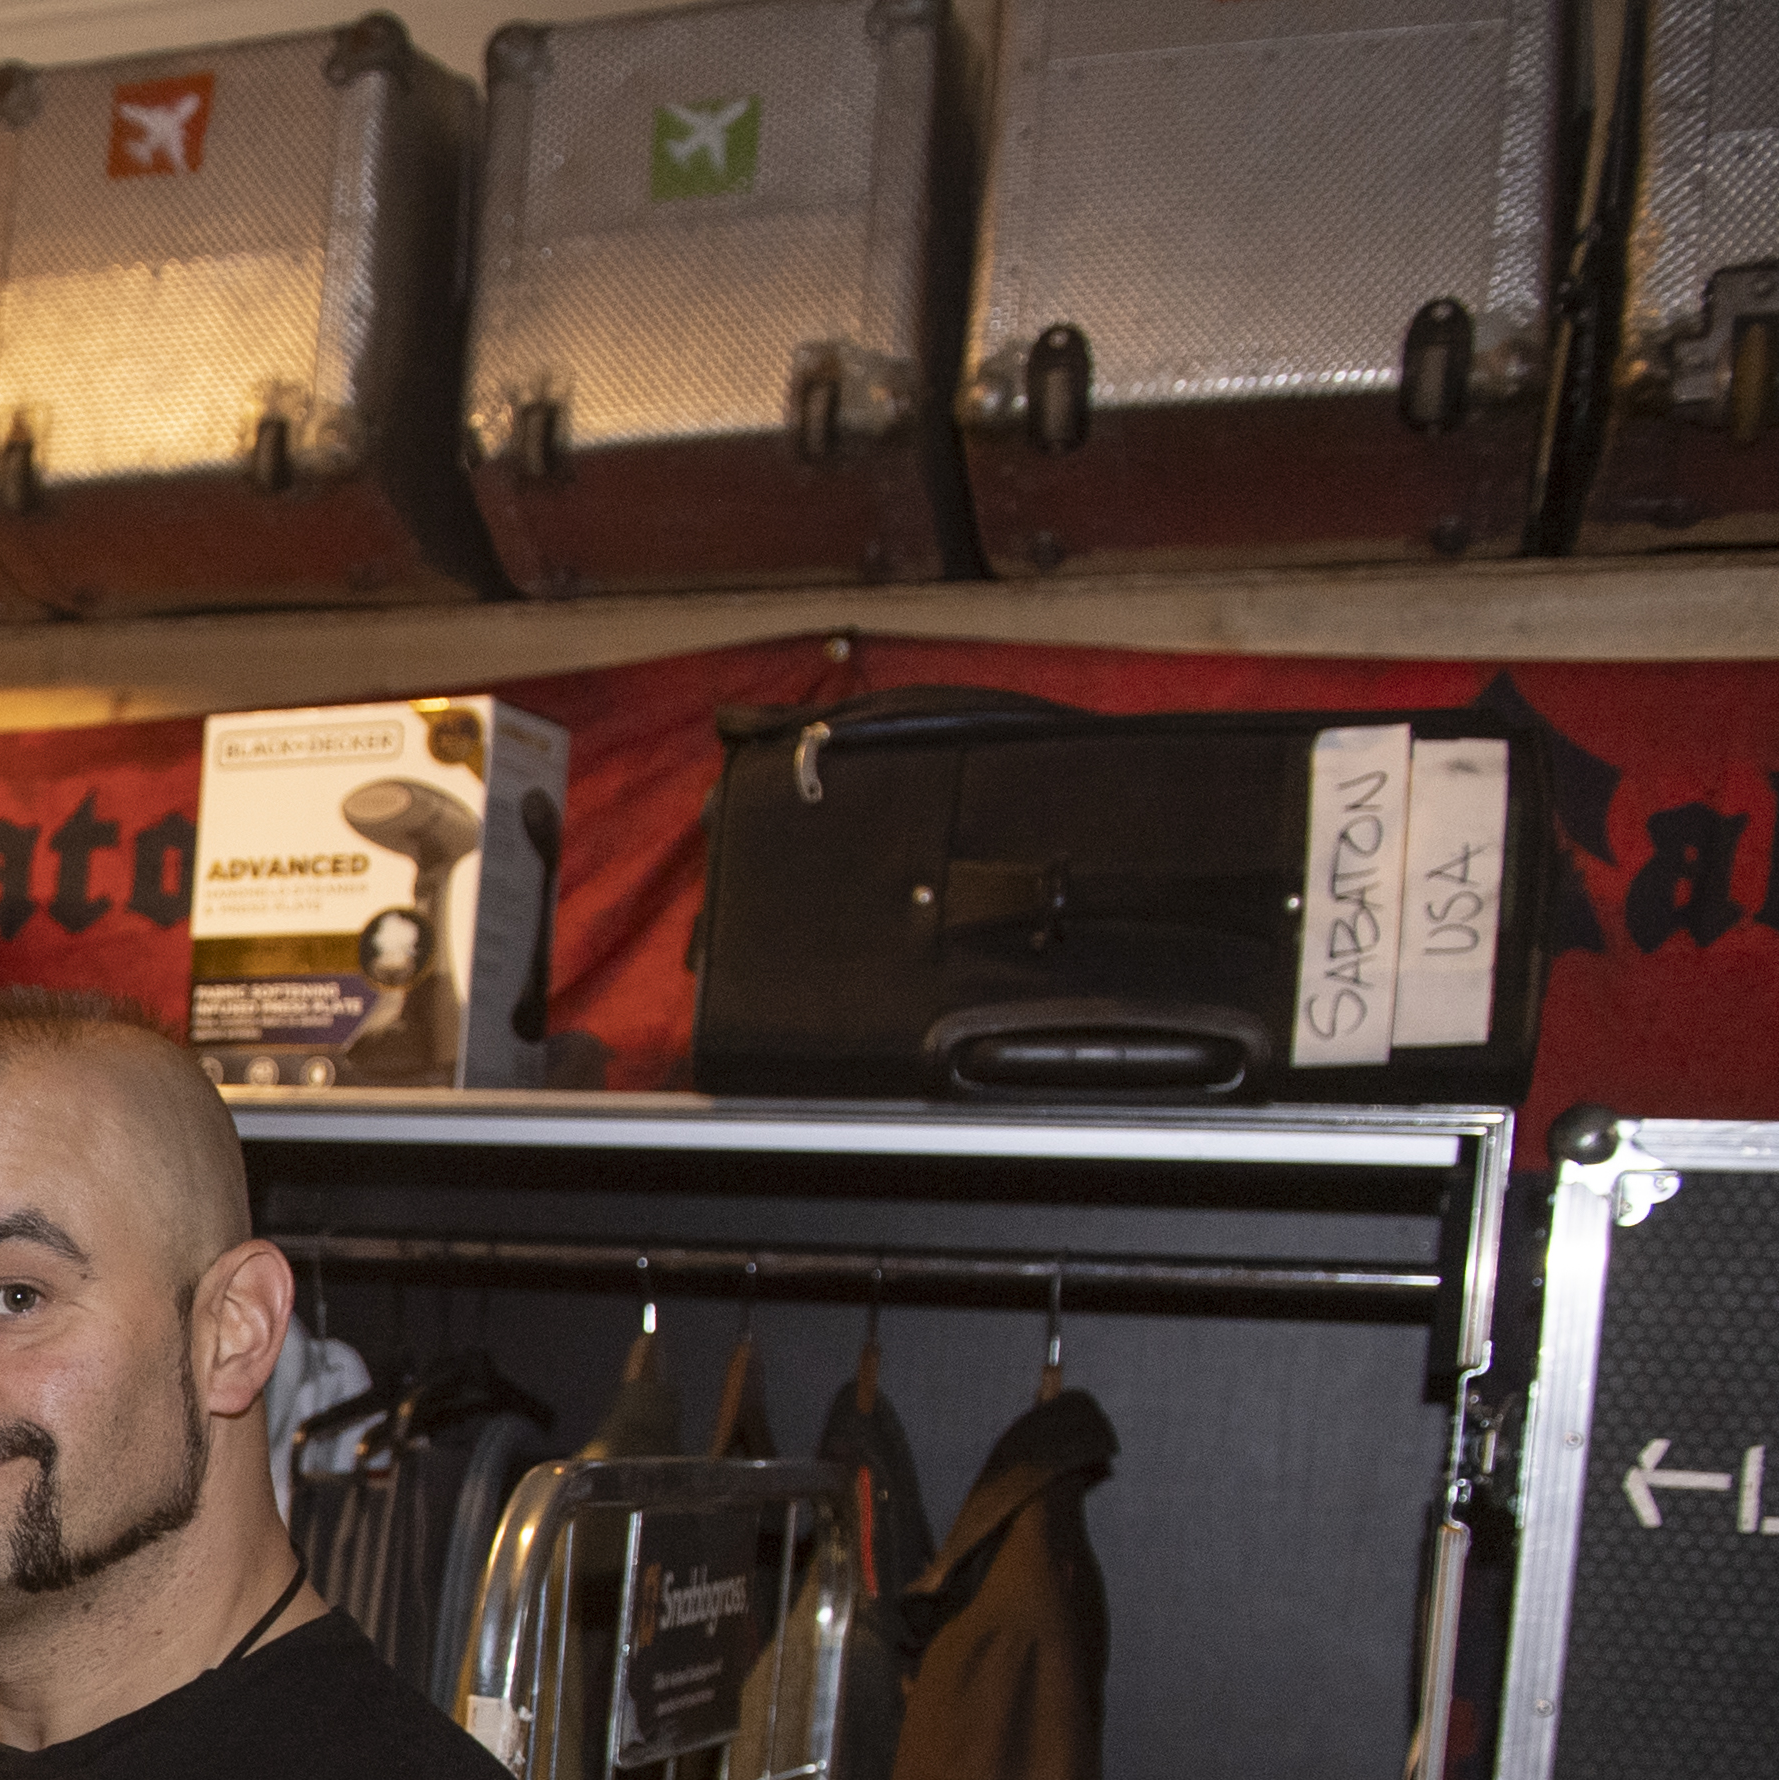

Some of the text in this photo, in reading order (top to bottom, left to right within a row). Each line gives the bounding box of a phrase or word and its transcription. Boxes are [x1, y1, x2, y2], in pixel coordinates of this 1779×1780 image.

[206, 853, 371, 882] ADVANCED
[1307, 769, 1389, 1041] SABATON
[1424, 841, 1491, 955] USA
